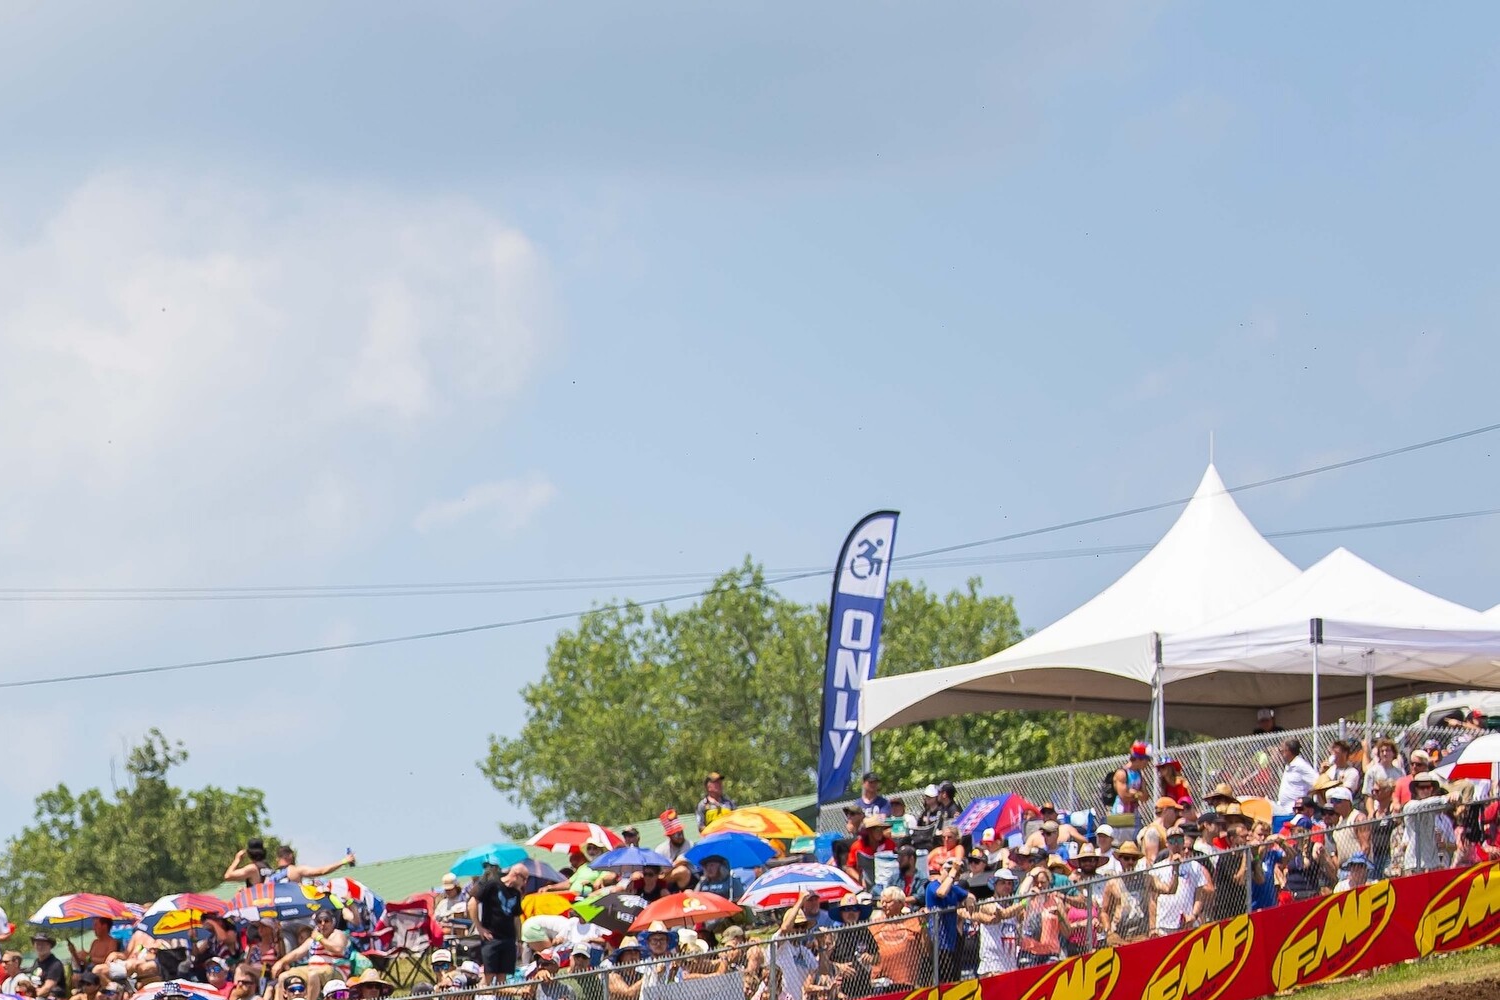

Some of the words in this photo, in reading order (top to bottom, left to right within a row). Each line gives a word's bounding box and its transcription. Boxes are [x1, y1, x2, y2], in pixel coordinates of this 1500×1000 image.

[830, 609, 874, 769] ONLY
[1278, 880, 1389, 992] FMF
[1421, 864, 1500, 957] FM
